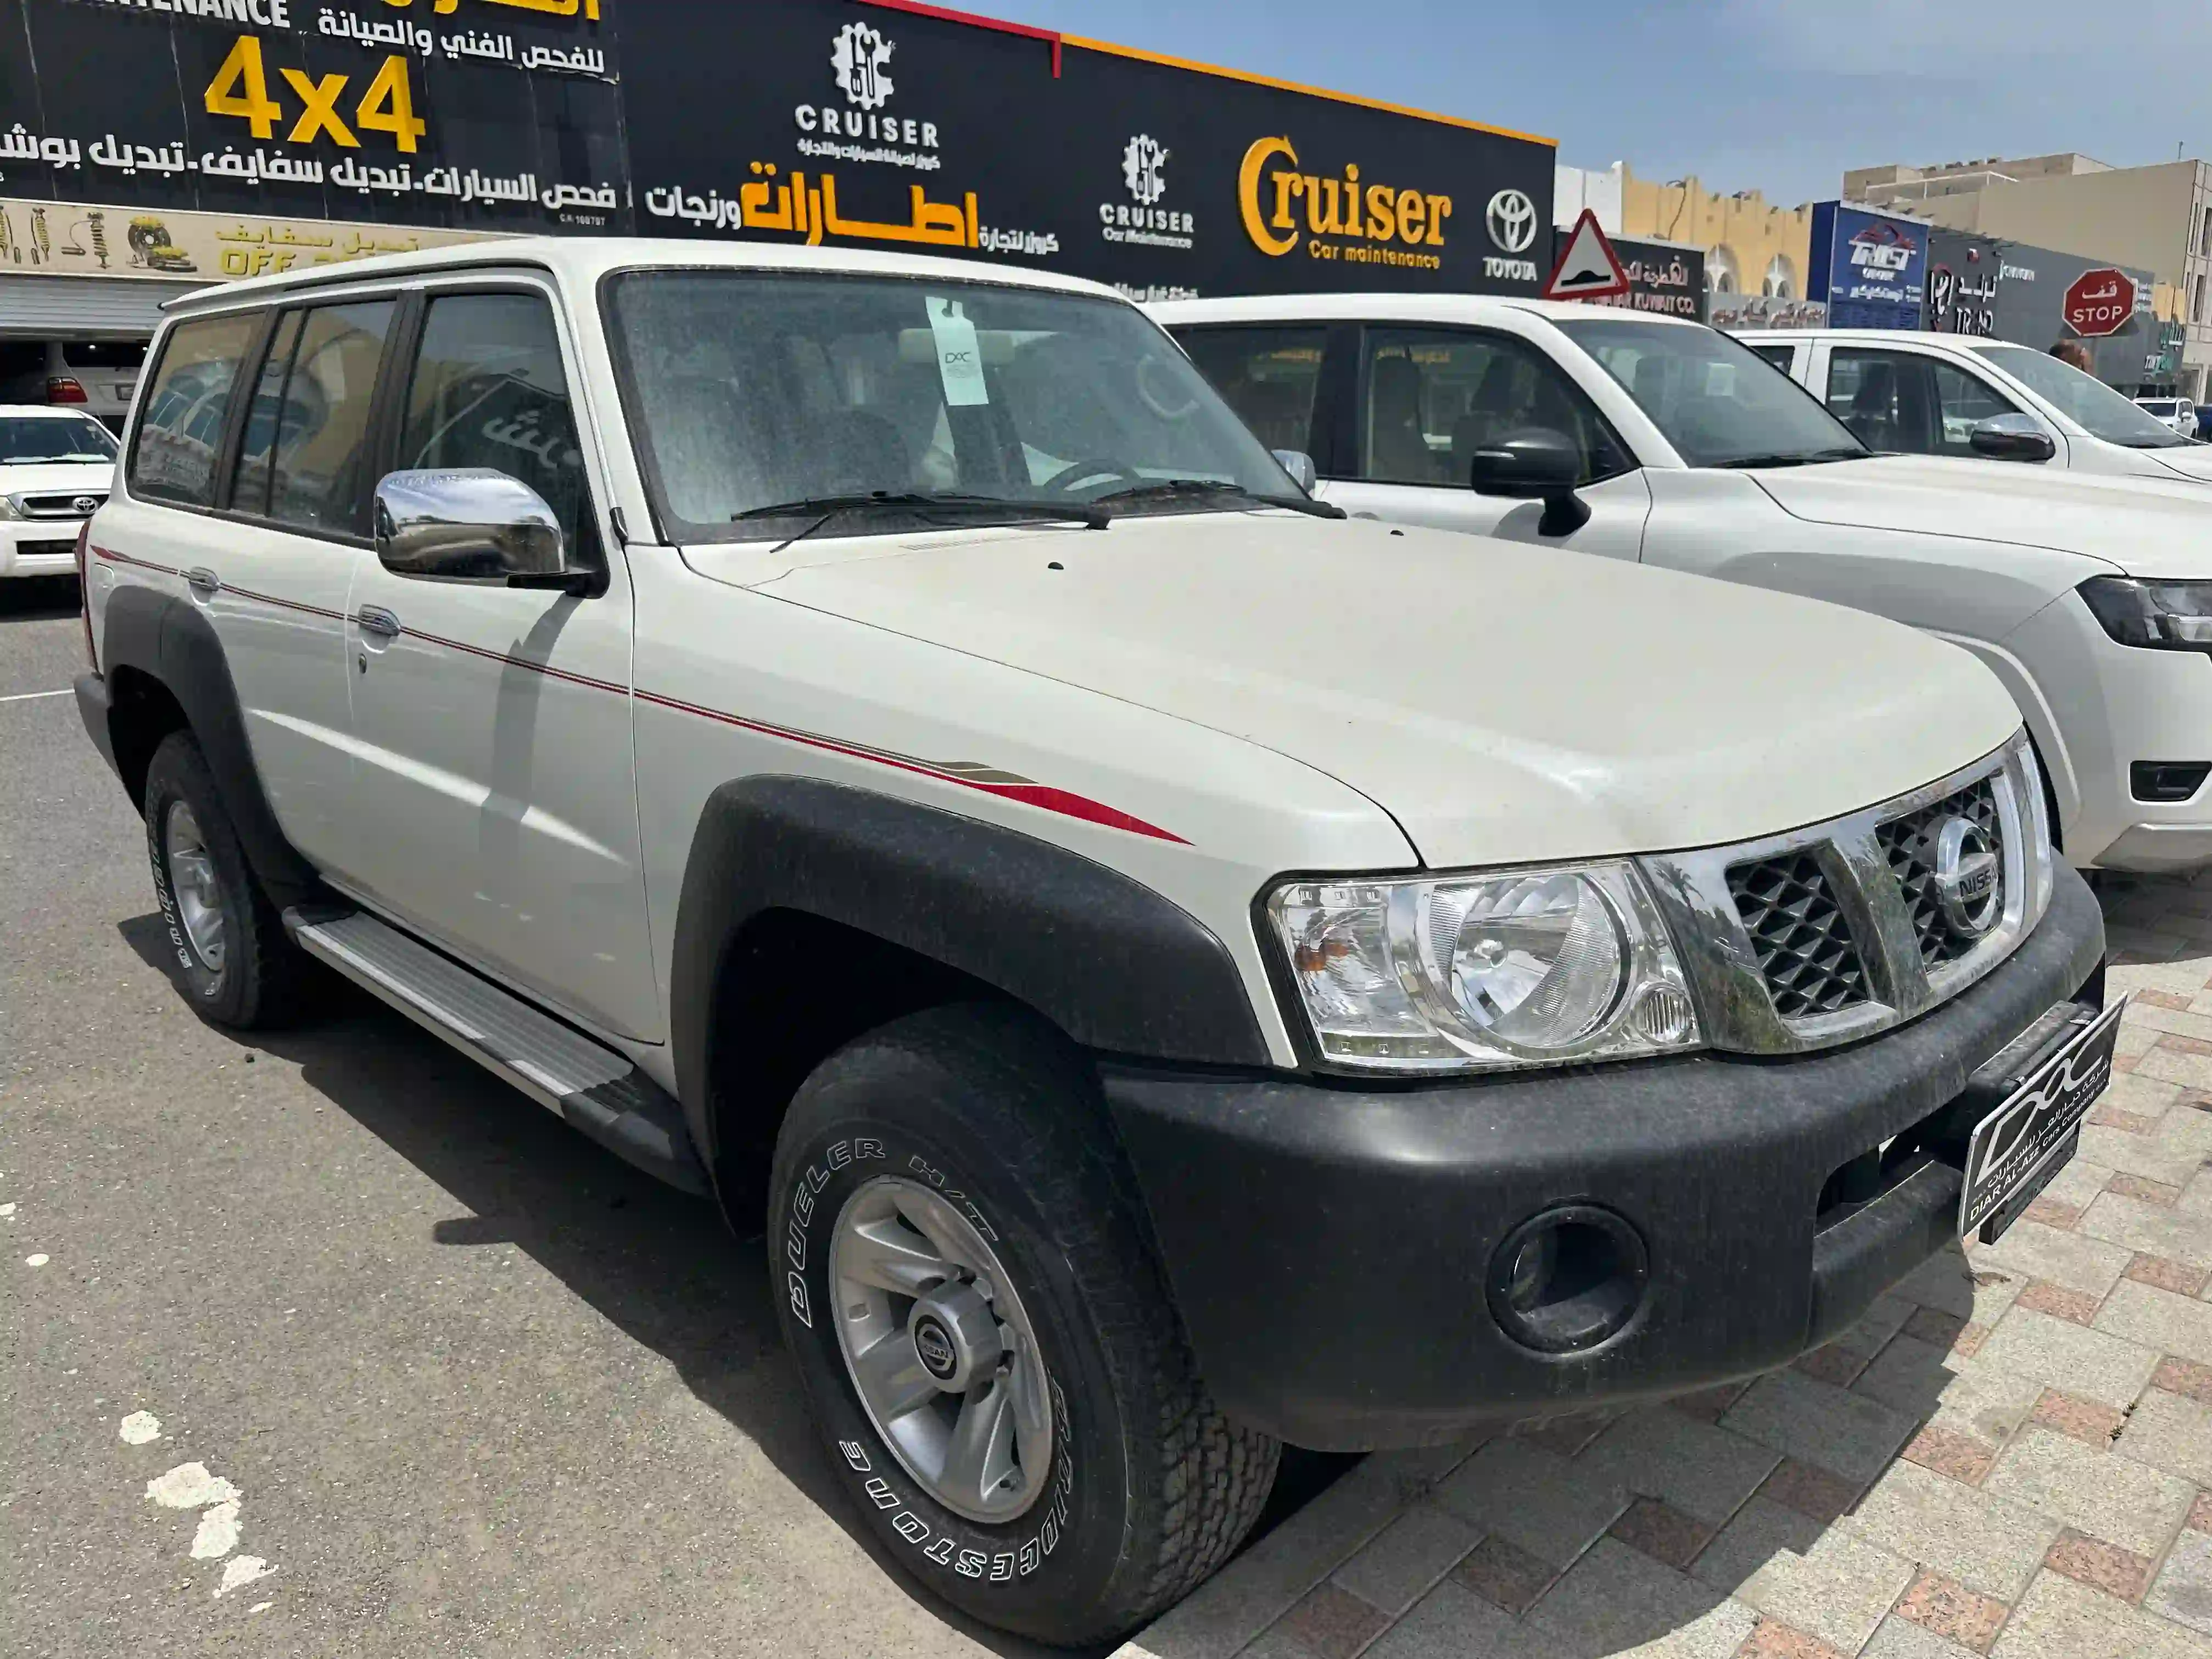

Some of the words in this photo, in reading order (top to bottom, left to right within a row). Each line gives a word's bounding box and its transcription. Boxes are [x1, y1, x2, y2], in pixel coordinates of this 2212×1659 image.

[318, 8, 433, 55] والصيانة
[440, 30, 513, 60] الفني
[521, 46, 604, 73] للفحص
[204, 35, 426, 153] 4x4
[795, 104, 939, 148] CRUISER
[541, 182, 617, 209] فحص
[1238, 134, 1453, 256] Cruiser
[1099, 203, 1194, 233] CRUISER
[1309, 239, 1339, 260] Car
[1344, 246, 1441, 270] maintenance
[1483, 256, 1538, 282] TOYOTA
[2081, 280, 2118, 299] قف
[2072, 306, 2123, 323] STOP
[1970, 1184, 2001, 1221] DIAR
[2042, 1126, 2060, 1147] Cars
[2062, 1089, 2095, 1126] Company
[787, 1138, 886, 1328] DUELER
